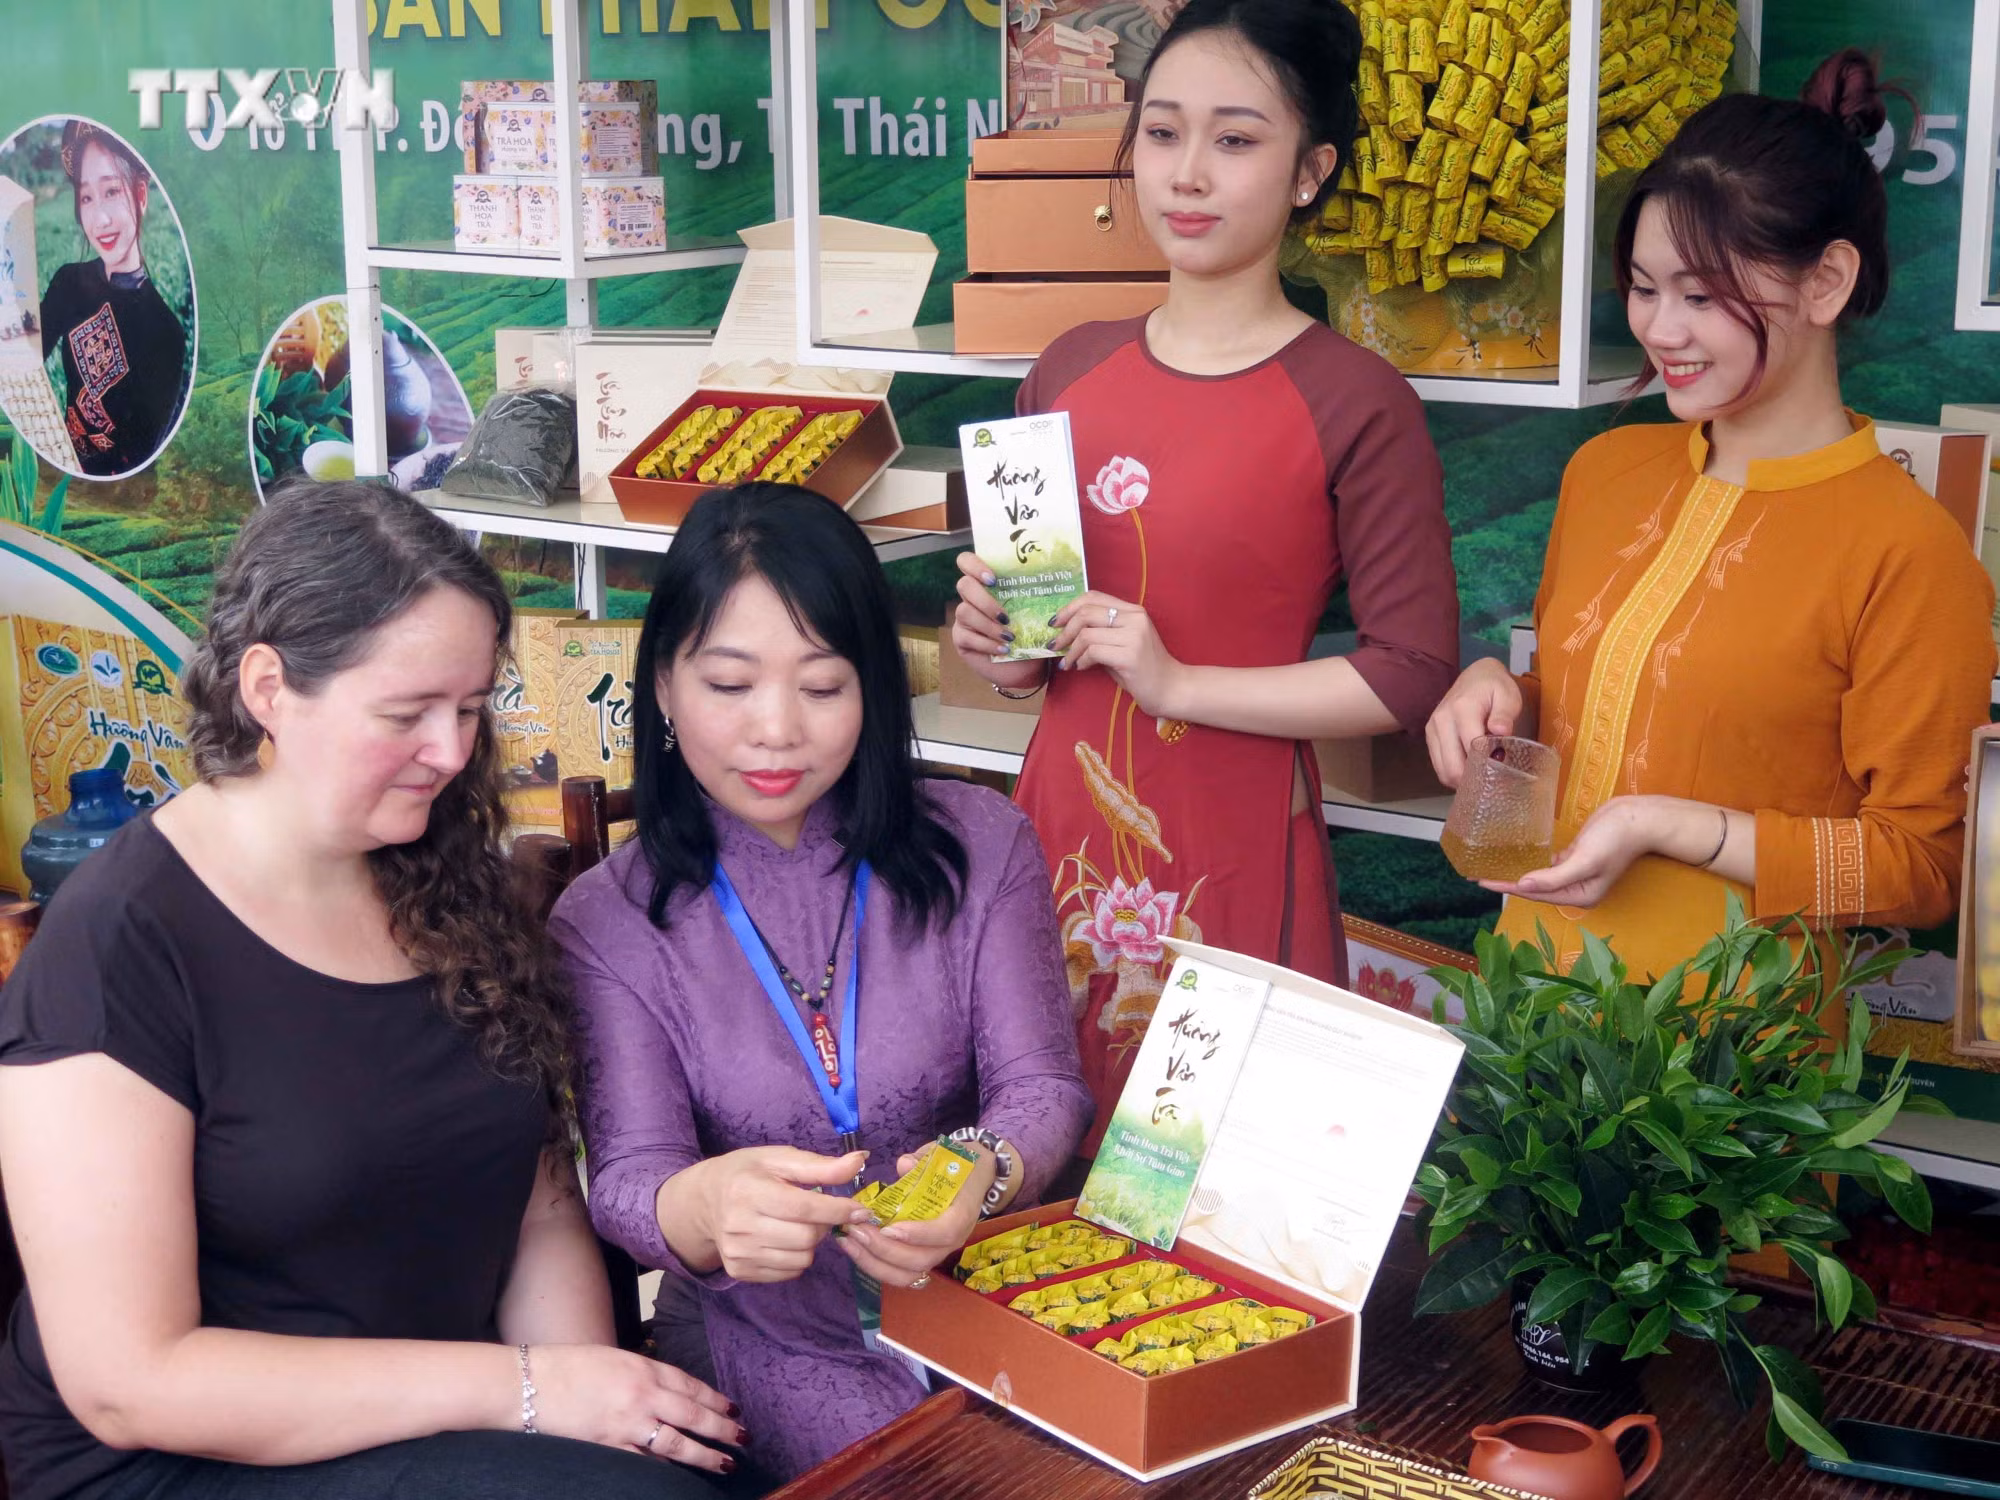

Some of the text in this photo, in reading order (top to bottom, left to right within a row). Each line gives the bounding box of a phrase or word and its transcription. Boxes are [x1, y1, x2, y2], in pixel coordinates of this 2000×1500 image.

[833, 97, 947, 157] Thái
[513, 137, 532, 146] HOA
[469, 204, 497, 212] THANH
[477, 220, 491, 228] TRÀ
[1004, 492, 1039, 526] Vân
[997, 570, 1073, 587] Tinh Hoa Trà Việt
[147, 720, 184, 749] Vân
[1888, 996, 1918, 1015] Vân
[1166, 1049, 1196, 1083] Vân
[1140, 1136, 1158, 1153] Hoa
[1160, 1144, 1175, 1159] Trà
